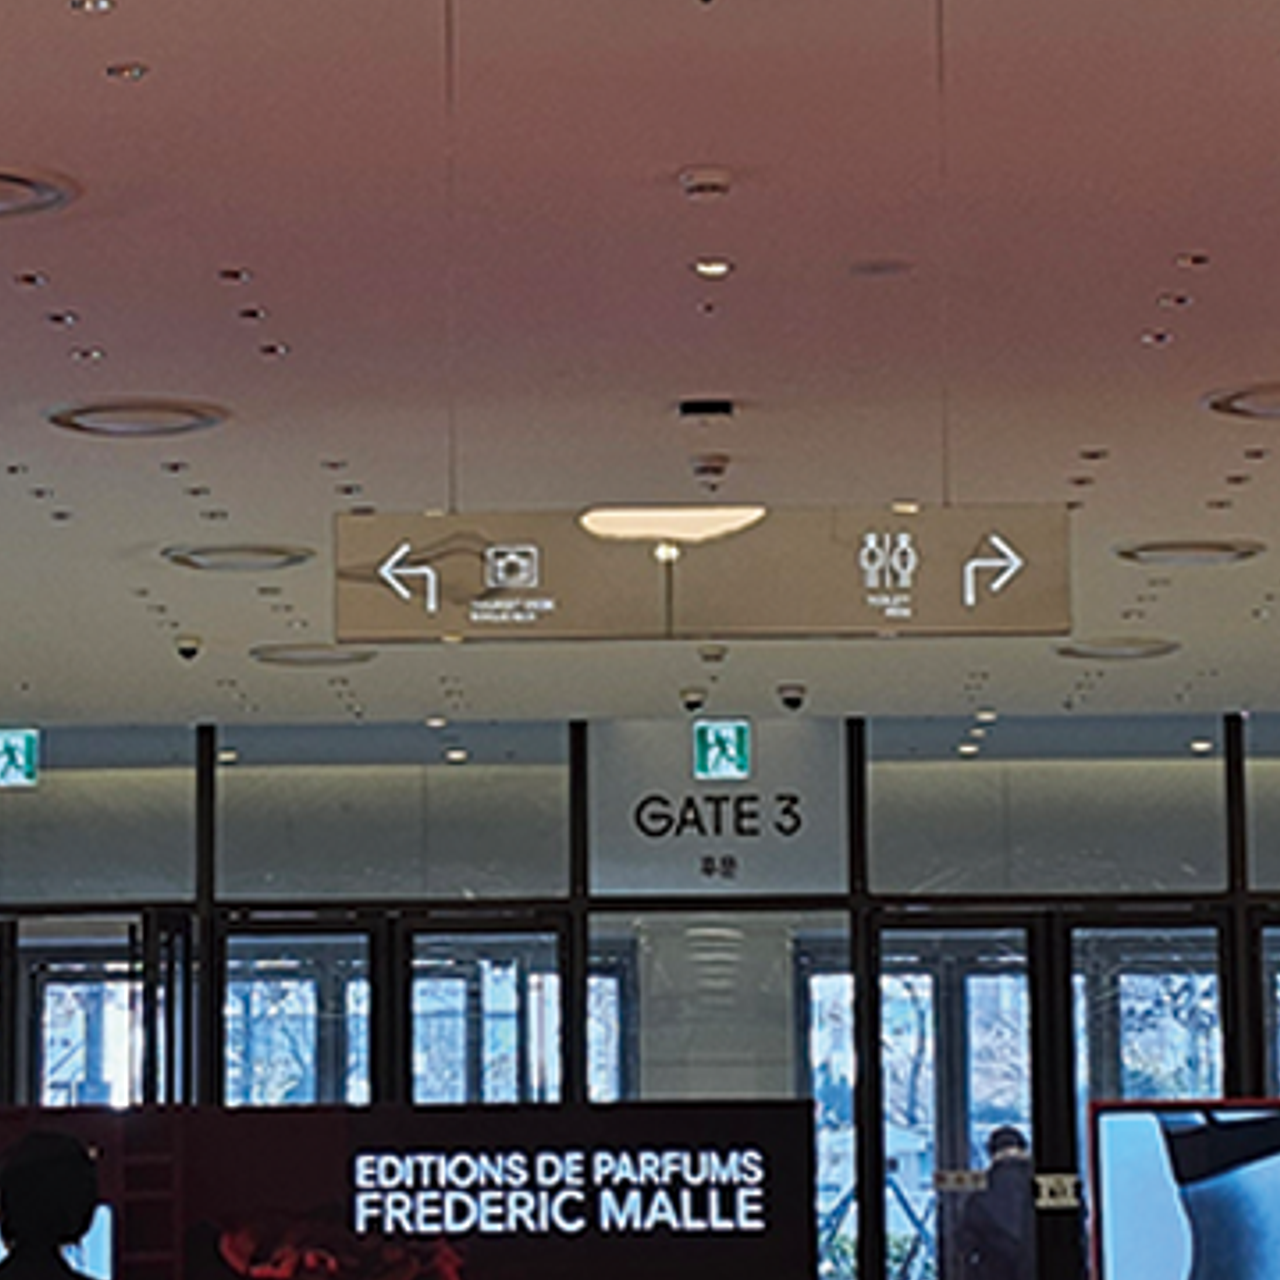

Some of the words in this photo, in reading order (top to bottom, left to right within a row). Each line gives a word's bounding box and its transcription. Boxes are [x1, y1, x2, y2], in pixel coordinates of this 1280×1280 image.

[634, 794, 760, 838] GATE
[774, 794, 803, 837] 3
[355, 1154, 527, 1188] EDITIONS
[536, 1153, 585, 1186] DE
[593, 1151, 765, 1185] PARFUMS
[355, 1190, 586, 1233] FREDERIC
[601, 1188, 766, 1231] MALLE
